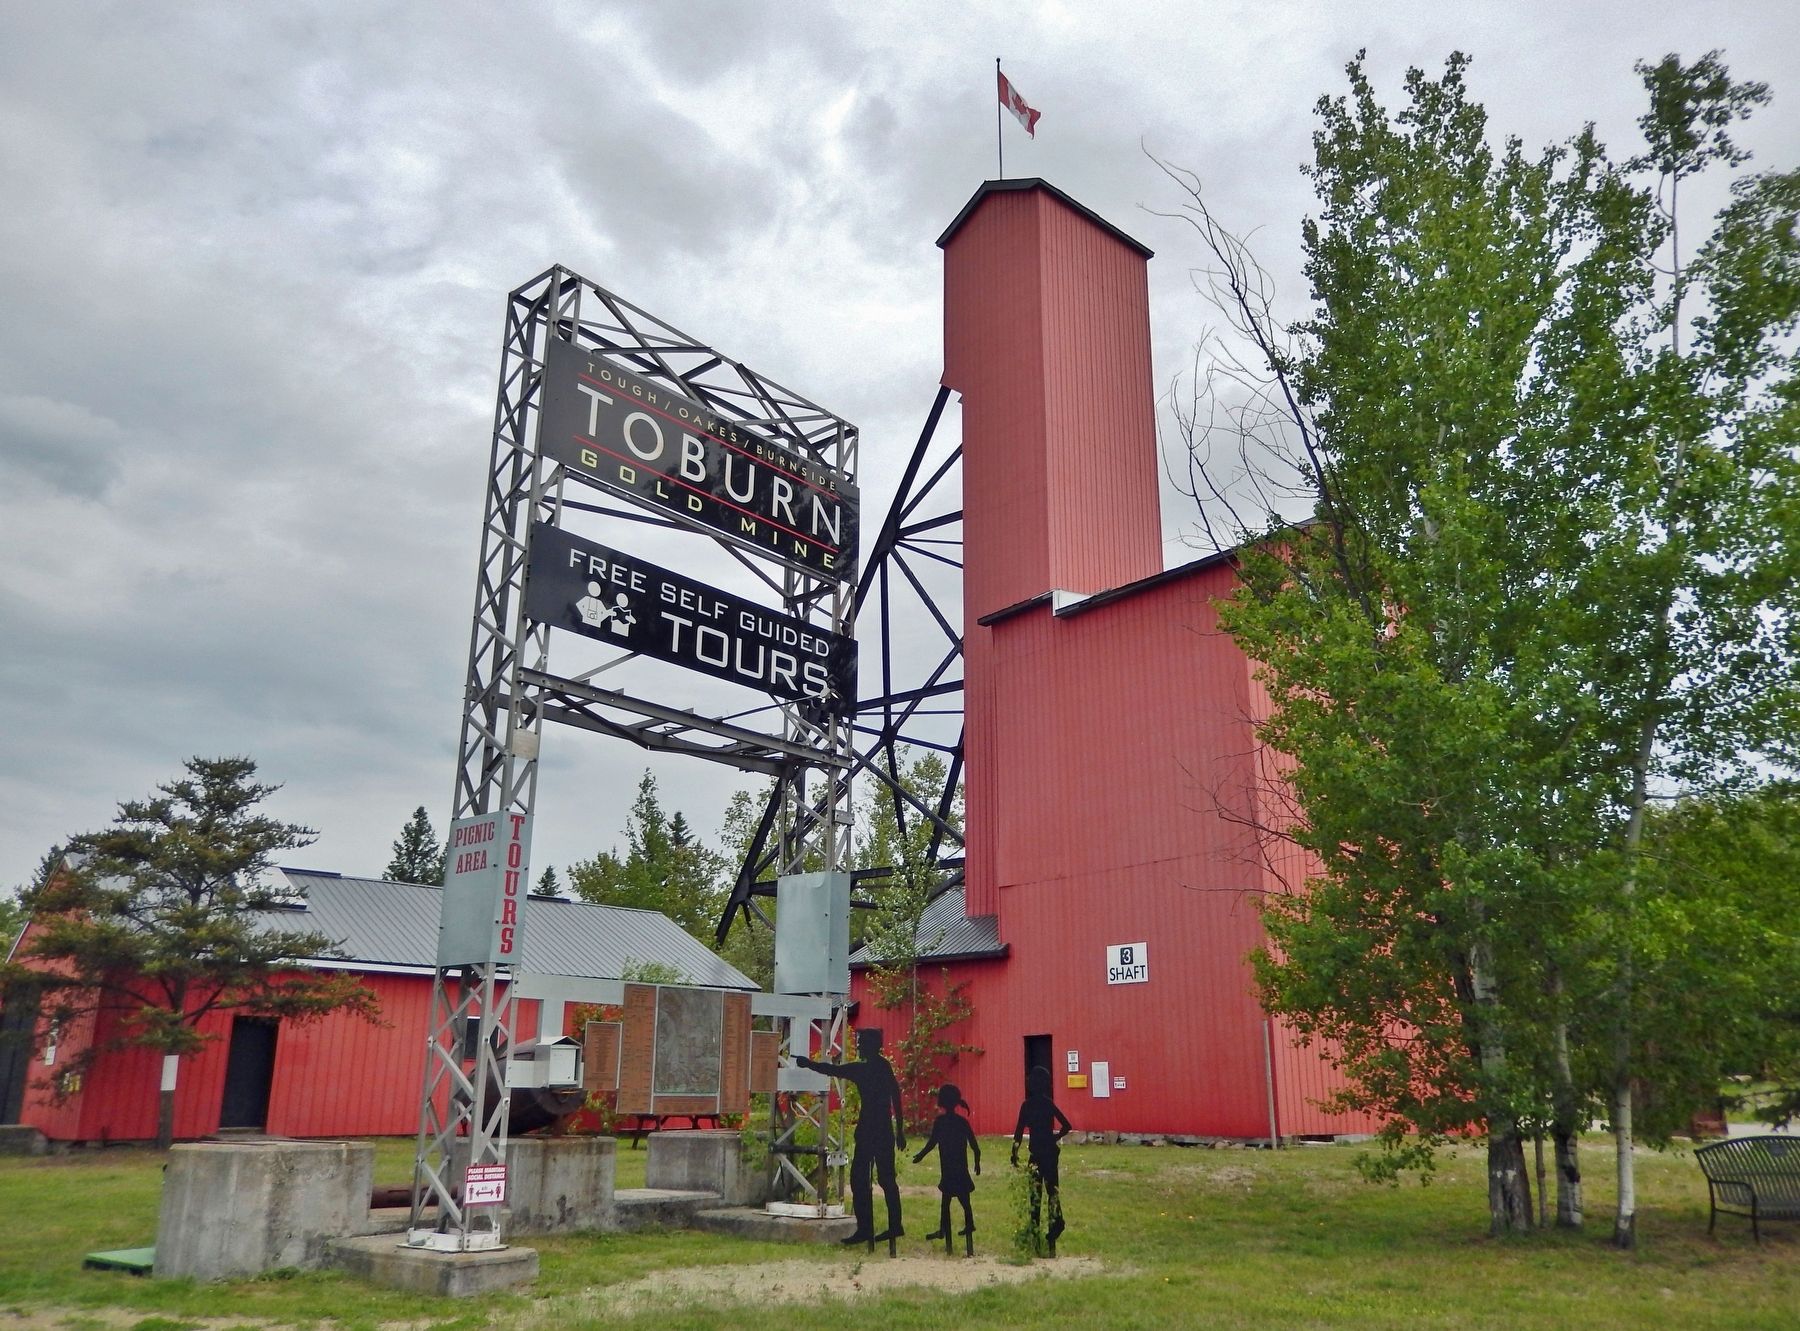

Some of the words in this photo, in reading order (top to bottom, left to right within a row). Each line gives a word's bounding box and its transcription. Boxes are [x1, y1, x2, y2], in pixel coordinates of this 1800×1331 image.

[577, 383, 841, 546] TOBURN
[756, 444, 836, 491] BURNSIDE
[581, 448, 703, 512] GOLD
[740, 516, 834, 570] MINE
[569, 548, 647, 594] FREE
[660, 581, 728, 620] SELF
[739, 611, 830, 658] GUIDED
[660, 611, 831, 698] TOURS
[455, 821, 495, 847] PICNIC
[456, 850, 487, 874] AREA
[500, 815, 525, 954] TOURS
[1109, 965, 1146, 982] SHAFT
[1122, 948, 1132, 964] 3
